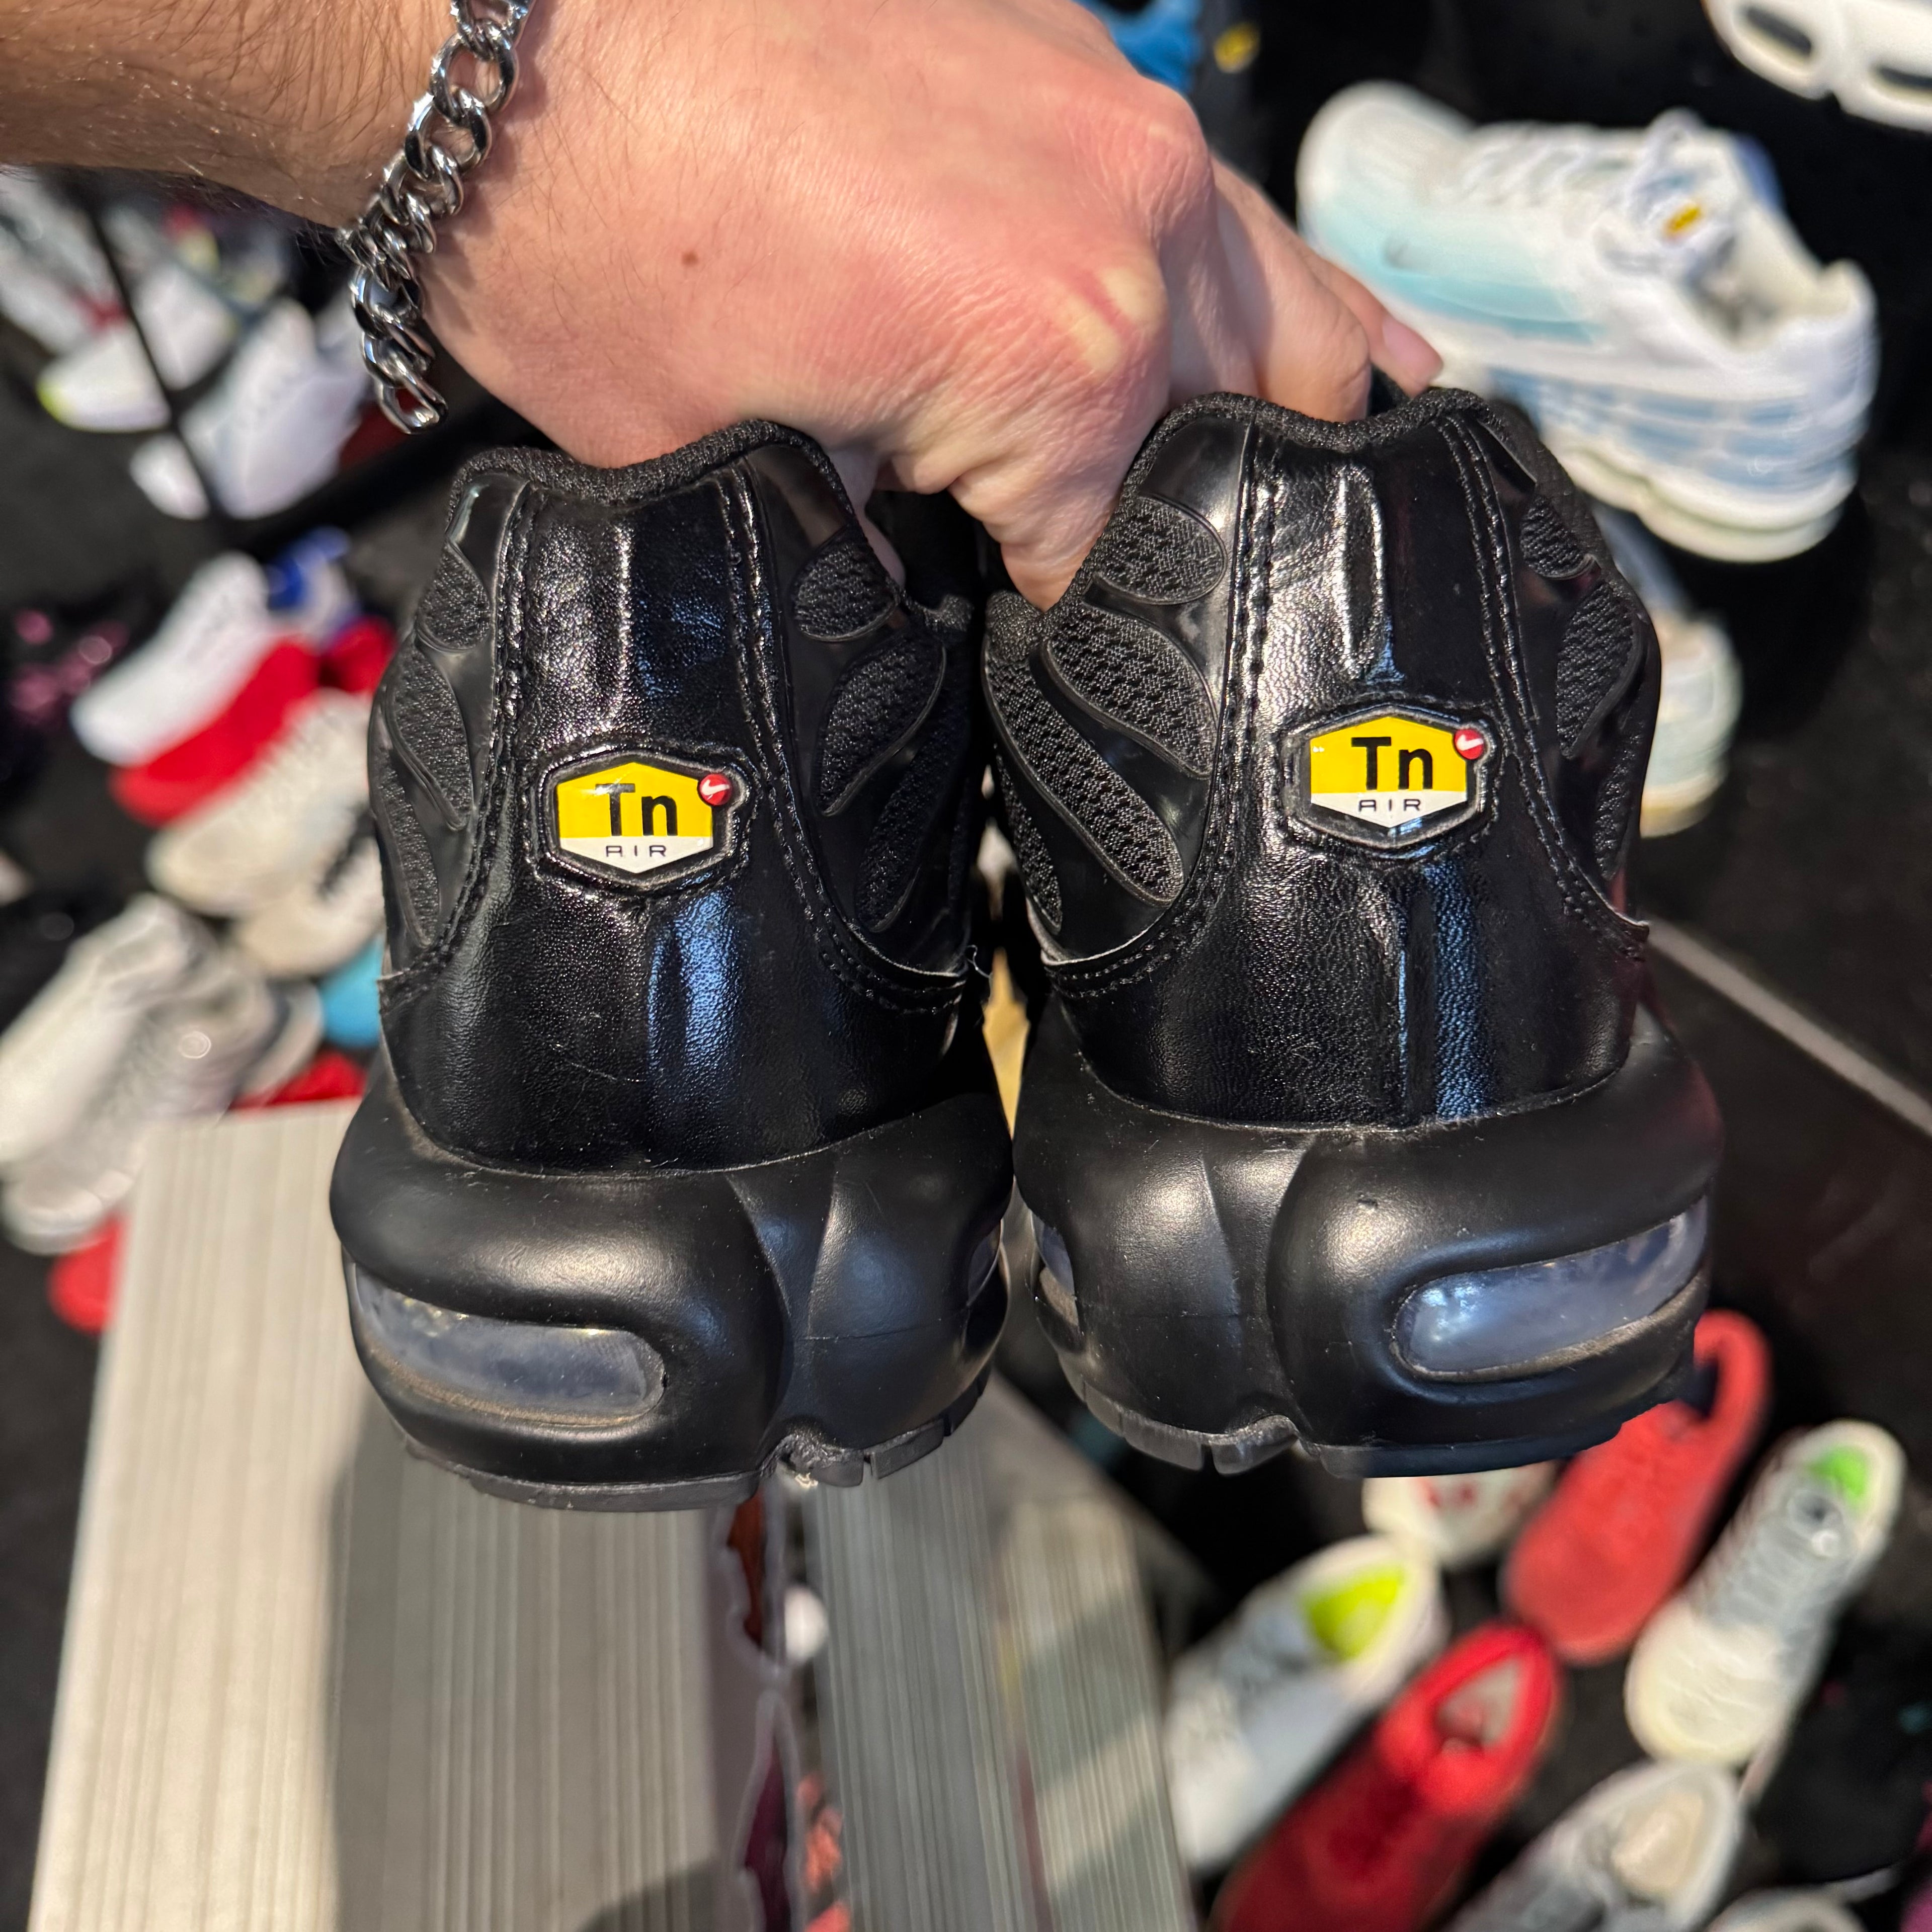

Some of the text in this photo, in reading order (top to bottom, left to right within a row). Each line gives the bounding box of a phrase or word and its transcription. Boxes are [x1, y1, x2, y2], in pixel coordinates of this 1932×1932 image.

[1351, 737, 1433, 790] Tn
[595, 783, 678, 836] Tn
[1358, 799, 1421, 812] AIR
[605, 845, 666, 857] AIR
